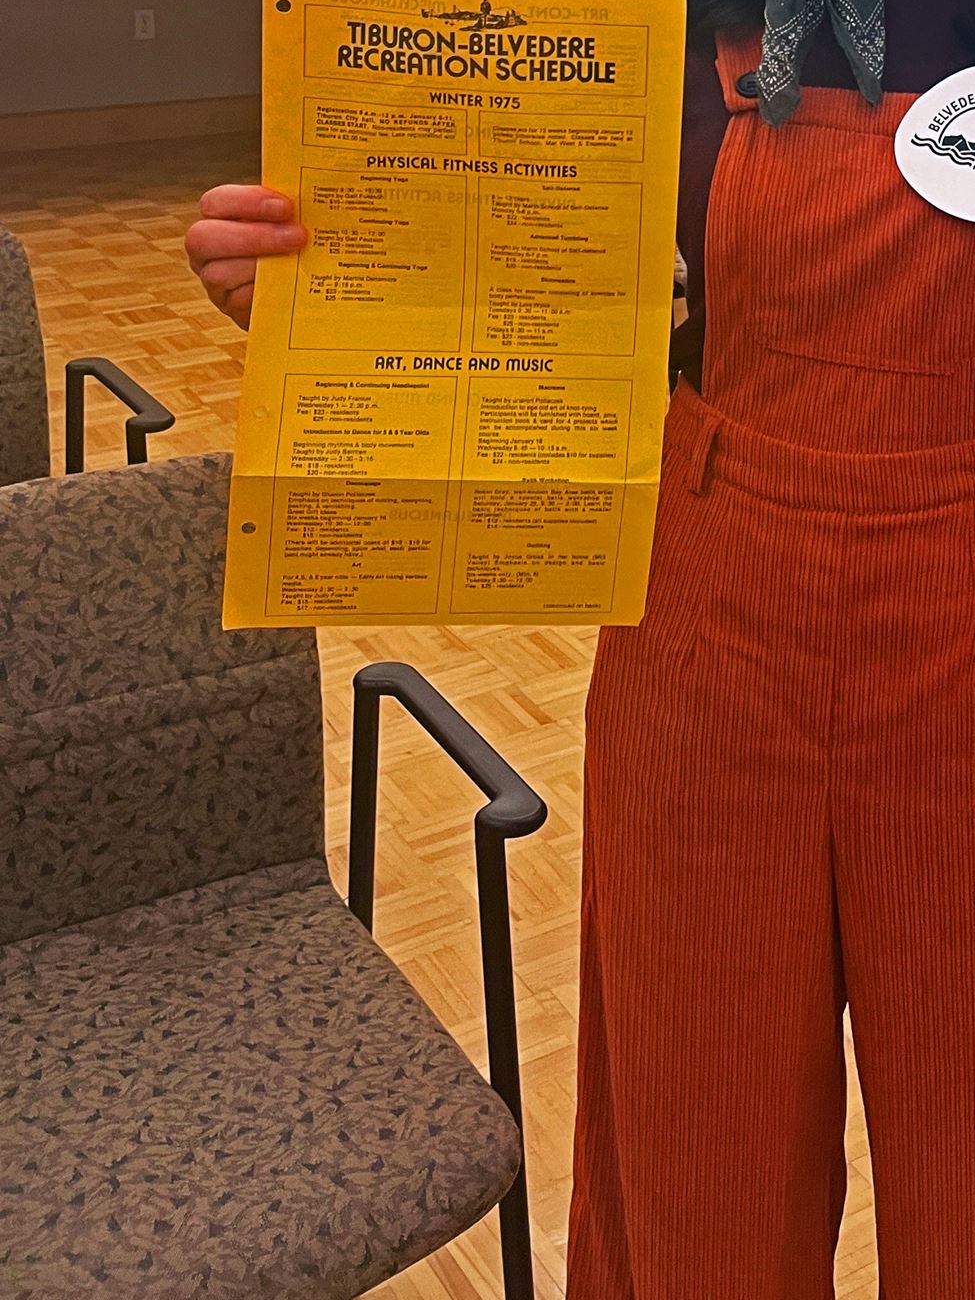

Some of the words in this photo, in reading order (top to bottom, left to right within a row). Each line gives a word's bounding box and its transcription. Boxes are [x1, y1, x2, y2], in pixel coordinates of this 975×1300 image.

[347, 21, 596, 59] TIBURON-BELVEDERE
[337, 46, 489, 79] RECREATION
[495, 58, 616, 83] SCHEDULE
[430, 91, 483, 108] WINTER
[489, 96, 521, 110] 1975
[366, 156, 438, 172] PHYSICAL
[443, 158, 498, 174] FITNESS
[503, 163, 577, 178] ACTIVITIES
[374, 356, 408, 371] ART,
[413, 357, 463, 371] DANCE
[469, 357, 500, 371] AND
[506, 358, 554, 373] MUSIC
